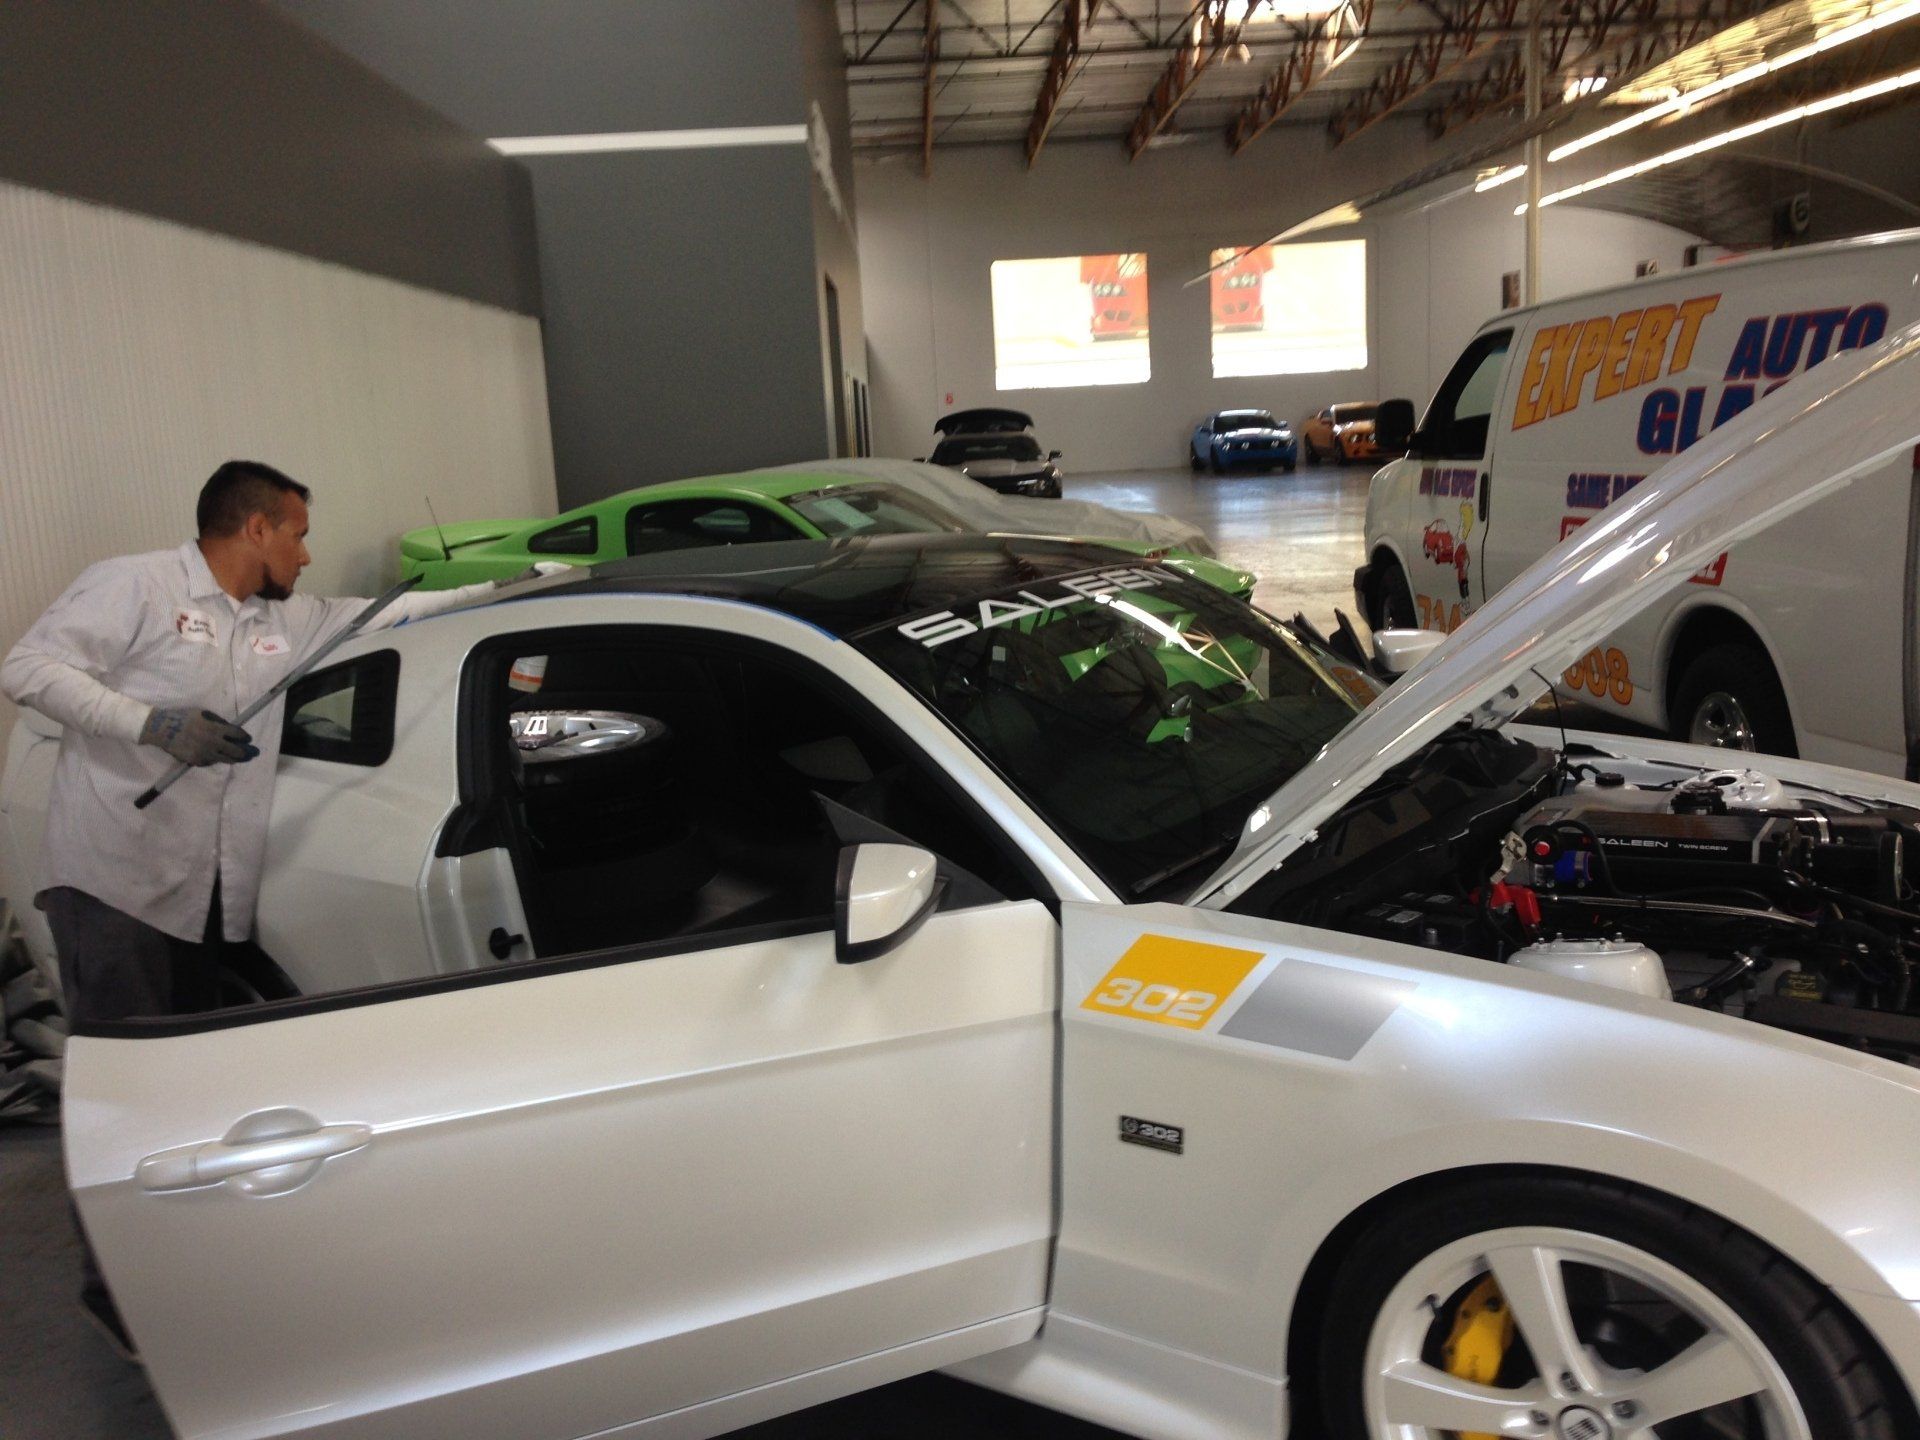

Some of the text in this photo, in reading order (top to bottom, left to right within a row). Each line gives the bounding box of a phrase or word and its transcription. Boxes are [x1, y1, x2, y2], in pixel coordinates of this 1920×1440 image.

[1512, 293, 1889, 431] EXPERT AUTO
[897, 565, 1184, 648] SALEEN
[1096, 977, 1218, 1022] 302
